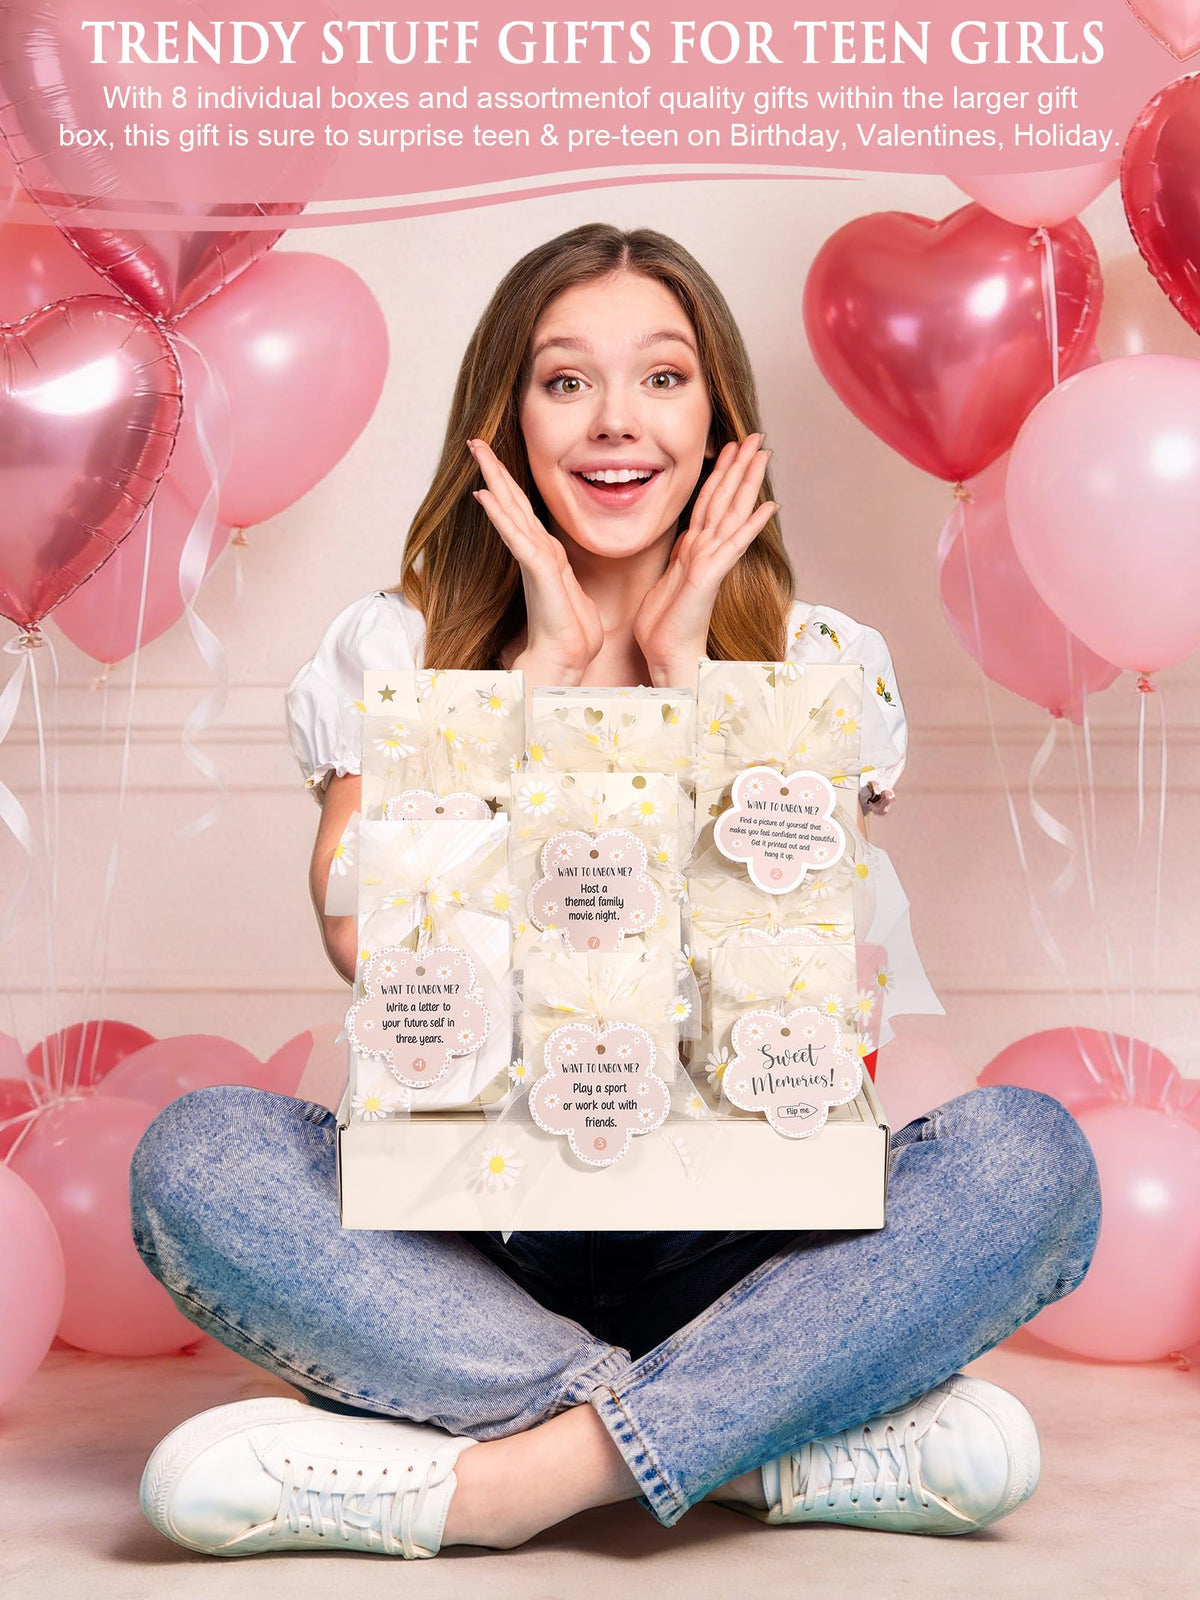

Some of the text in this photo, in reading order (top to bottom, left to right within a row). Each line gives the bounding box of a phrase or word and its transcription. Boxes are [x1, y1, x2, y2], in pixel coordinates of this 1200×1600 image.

[747, 800, 819, 815] WANT TO UNBOX ME?
[786, 822, 808, 830] yourself
[772, 830, 797, 839] confident
[767, 840, 787, 848] printed
[765, 851, 779, 859] hang
[786, 853, 794, 861] up.
[558, 867, 632, 877] WANT TO UNBOX ME?
[580, 884, 599, 893] Host
[565, 896, 624, 908] themed family
[569, 911, 620, 922] movie night.
[381, 984, 460, 994] WANT TO UNBOX ME?
[386, 1002, 409, 1012] Write
[418, 1002, 439, 1012] letter
[442, 1003, 451, 1012] to
[382, 1018, 455, 1030] your future self in
[396, 1034, 444, 1045] three years.
[758, 1043, 826, 1070] Sweet
[562, 1063, 639, 1073] WANT TO UNBOX ME?
[752, 1068, 834, 1095] Memories!
[573, 1083, 627, 1095] Play a sport
[563, 1100, 638, 1110] or work out with
[786, 1108, 798, 1116] Flip
[585, 1117, 617, 1128] friends.
